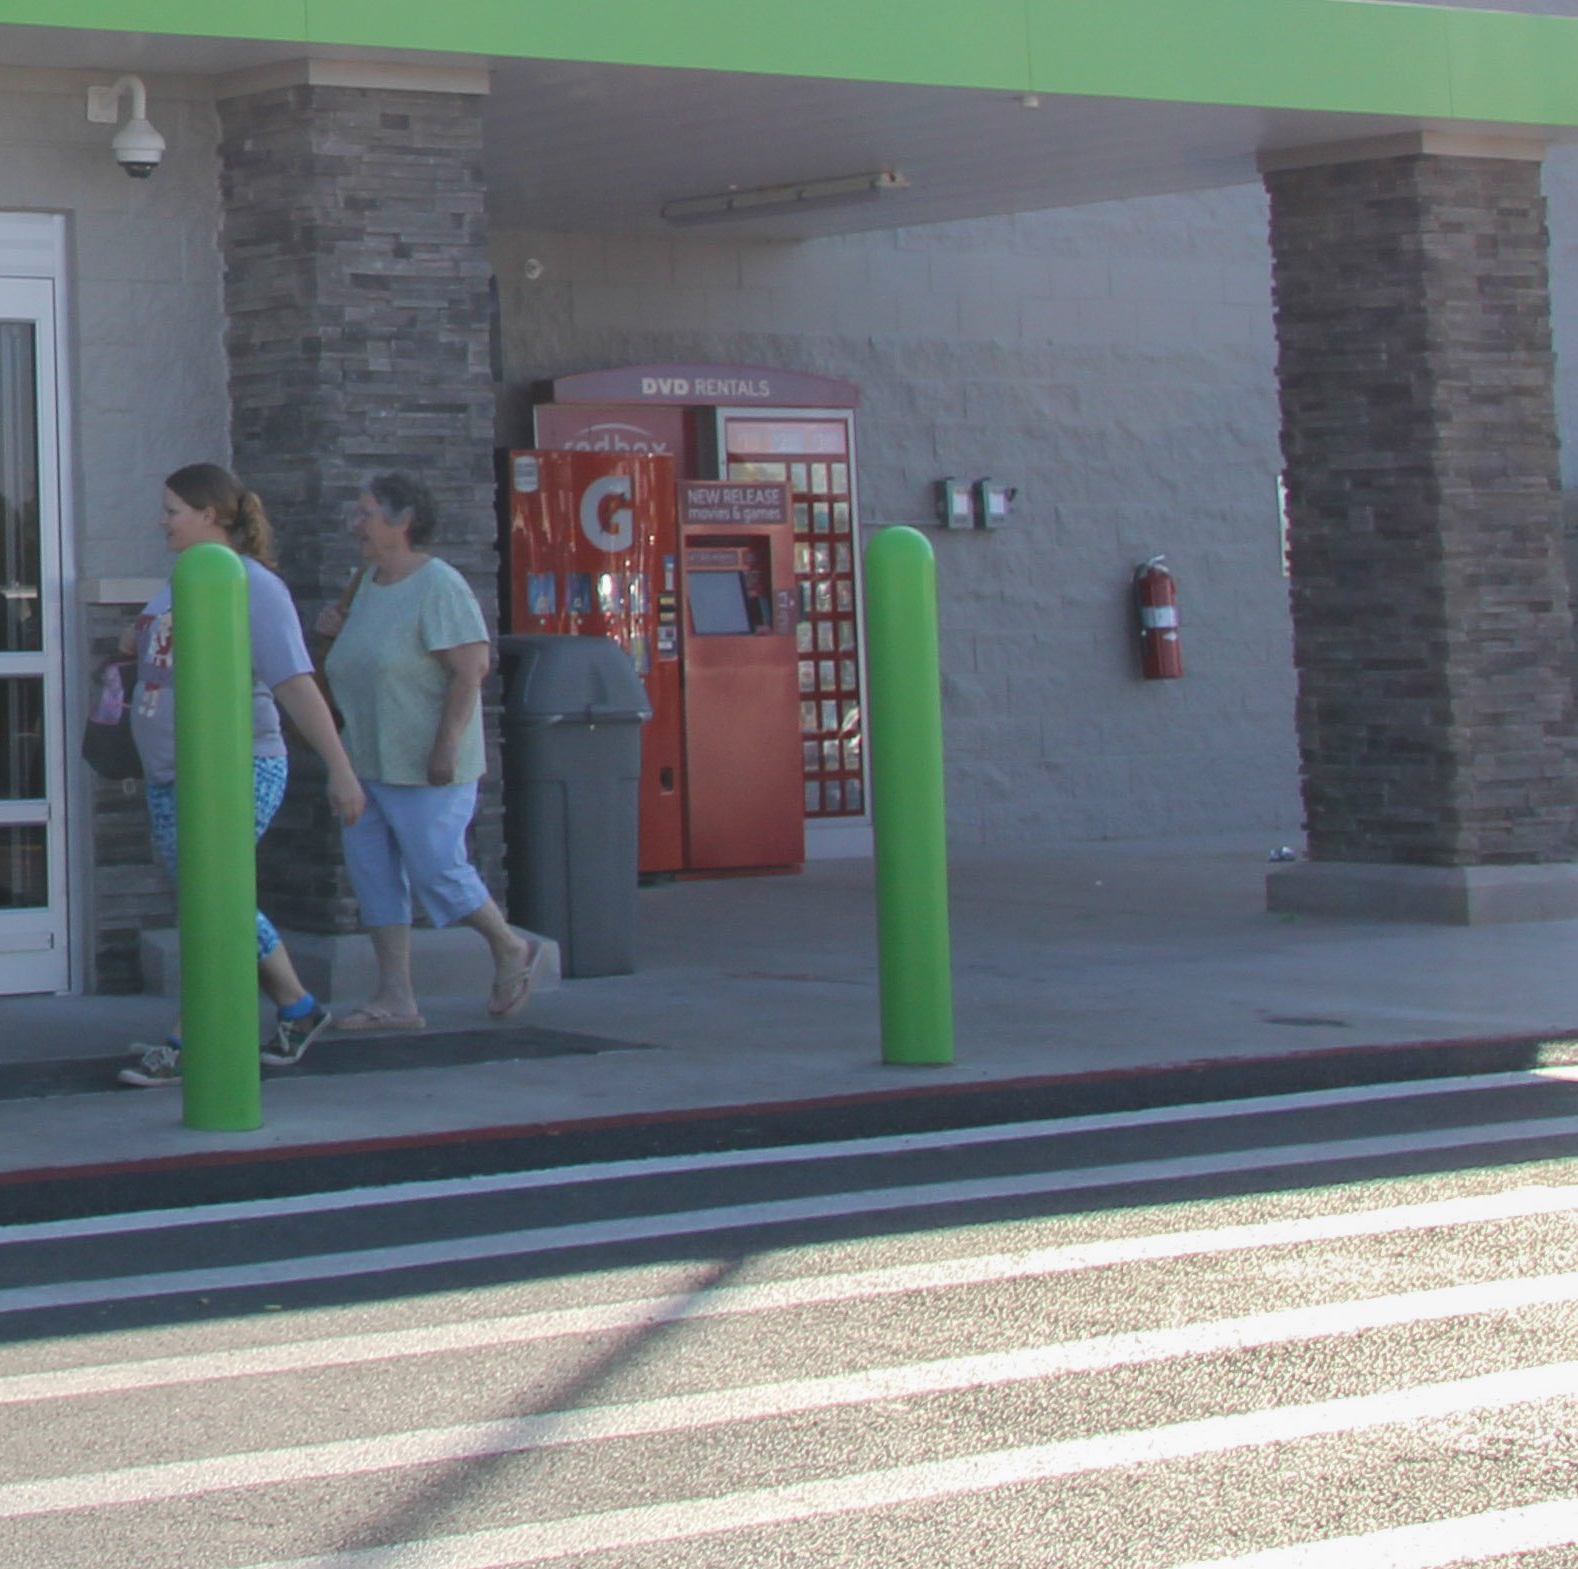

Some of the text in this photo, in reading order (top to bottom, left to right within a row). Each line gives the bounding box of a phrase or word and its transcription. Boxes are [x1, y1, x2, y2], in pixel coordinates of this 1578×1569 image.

[641, 377, 770, 397] DVD RENTALS
[688, 488, 781, 505] NEW RELEASE
[580, 475, 633, 552] G
